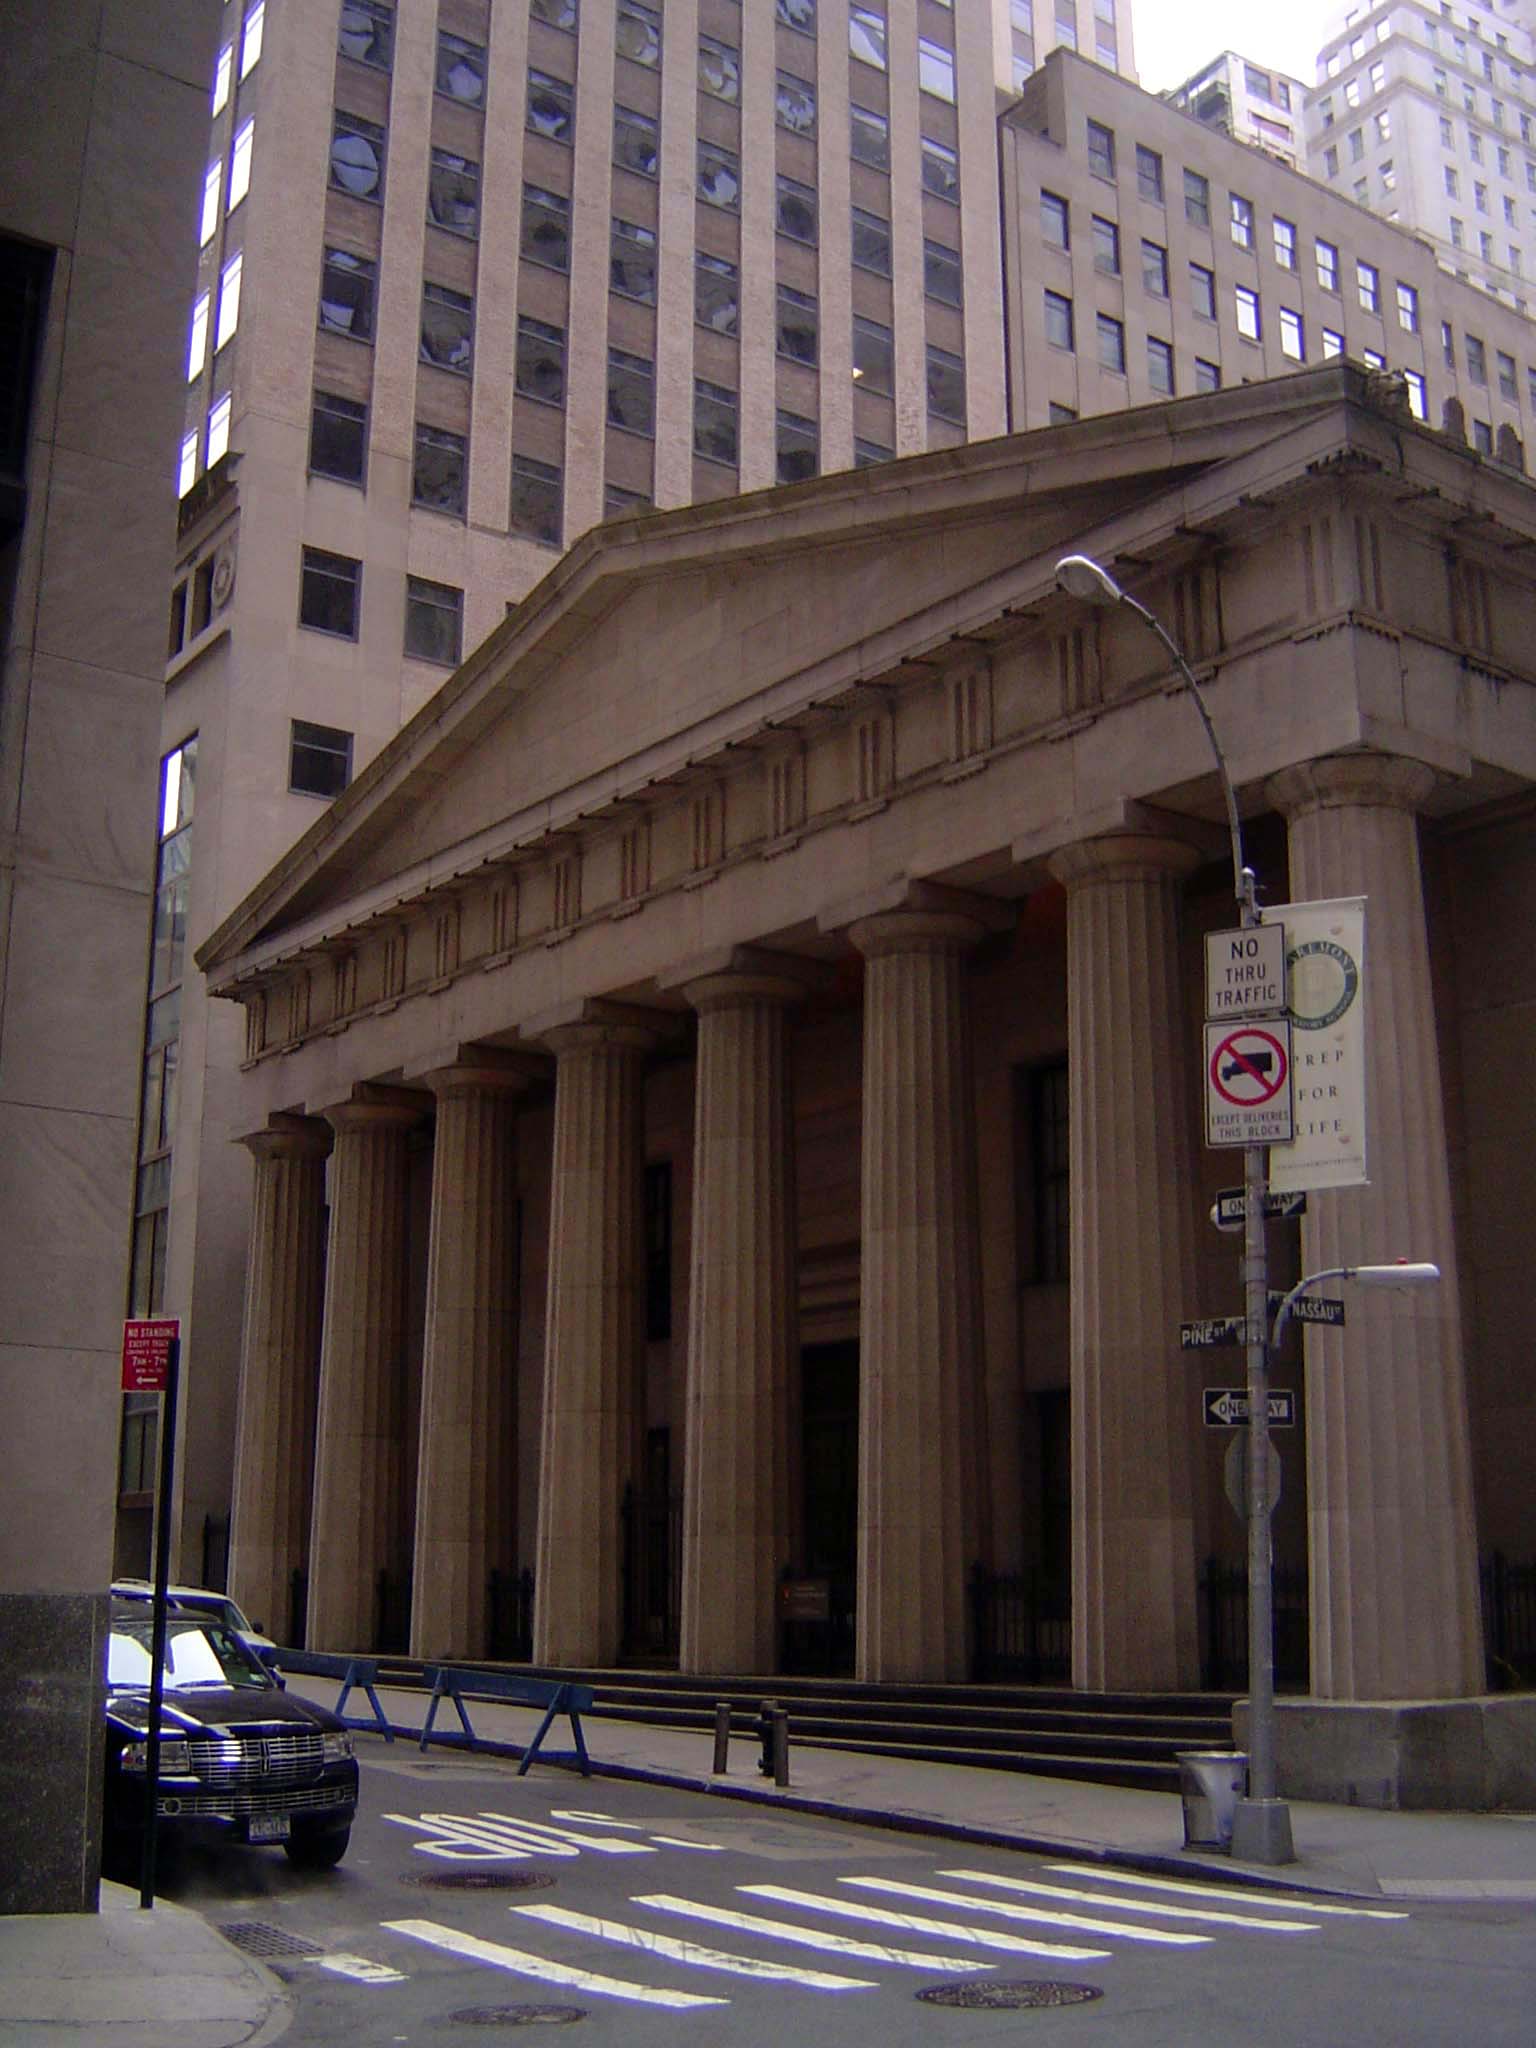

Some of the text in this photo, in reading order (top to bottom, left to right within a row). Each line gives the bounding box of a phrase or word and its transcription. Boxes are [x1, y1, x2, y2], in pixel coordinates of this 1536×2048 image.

[1231, 938, 1259, 960] NO
[1225, 963, 1267, 985] THRU
[1215, 984, 1277, 1008] TRAFFIC
[1298, 1084, 1338, 1101] FOR
[1219, 1124, 1281, 1139] THIS BLOCK
[1295, 1118, 1343, 1137] LIFE
[1229, 1199, 1245, 1214] ON
[1292, 1302, 1335, 1321] NASSAU
[128, 1327, 138, 1338] NO
[1181, 1326, 1214, 1345] PINE
[1219, 1401, 1282, 1416] ONE AY
